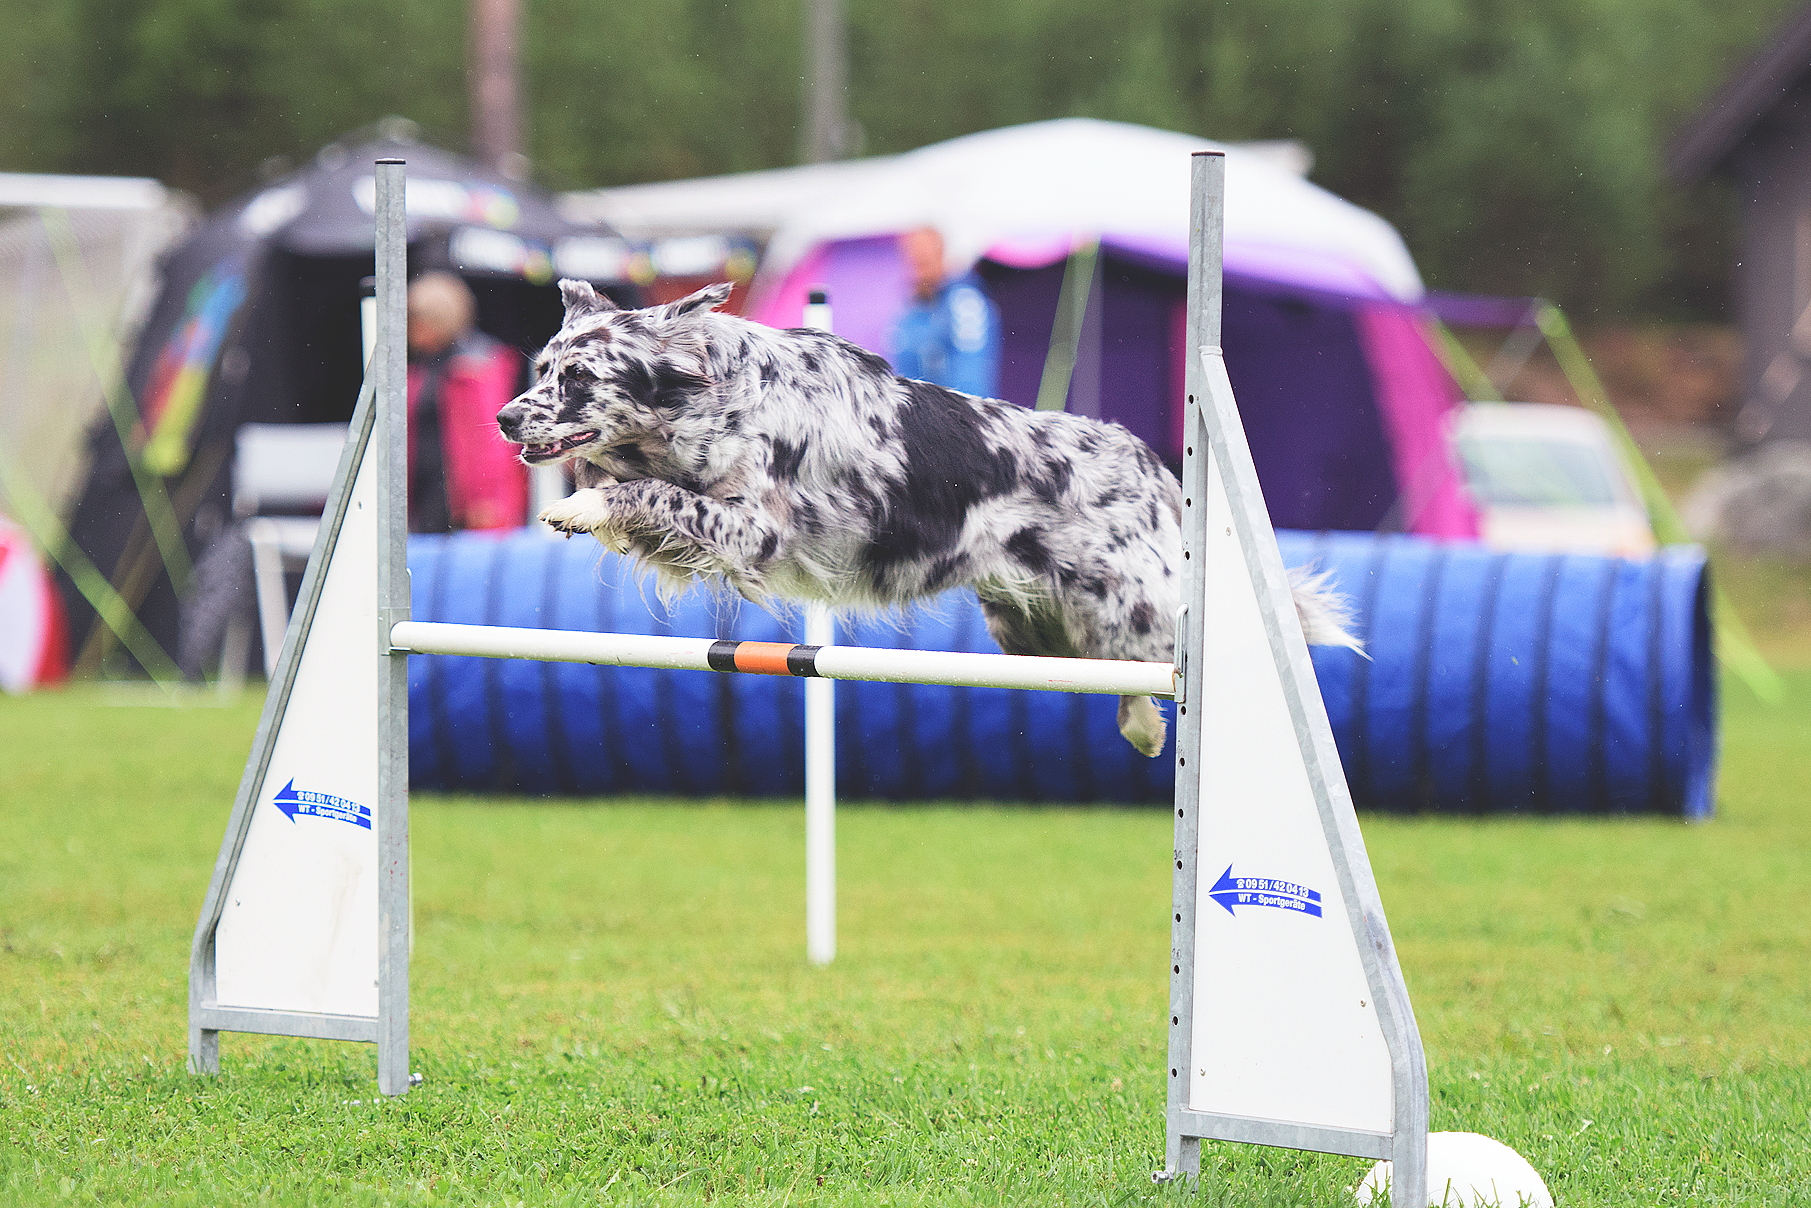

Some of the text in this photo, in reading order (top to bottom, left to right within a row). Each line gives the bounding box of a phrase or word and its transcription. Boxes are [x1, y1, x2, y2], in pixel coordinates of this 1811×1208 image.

[298, 804, 311, 813] WT
[1238, 893, 1252, 903] WT
[1258, 893, 1306, 911] Sportgeräte
